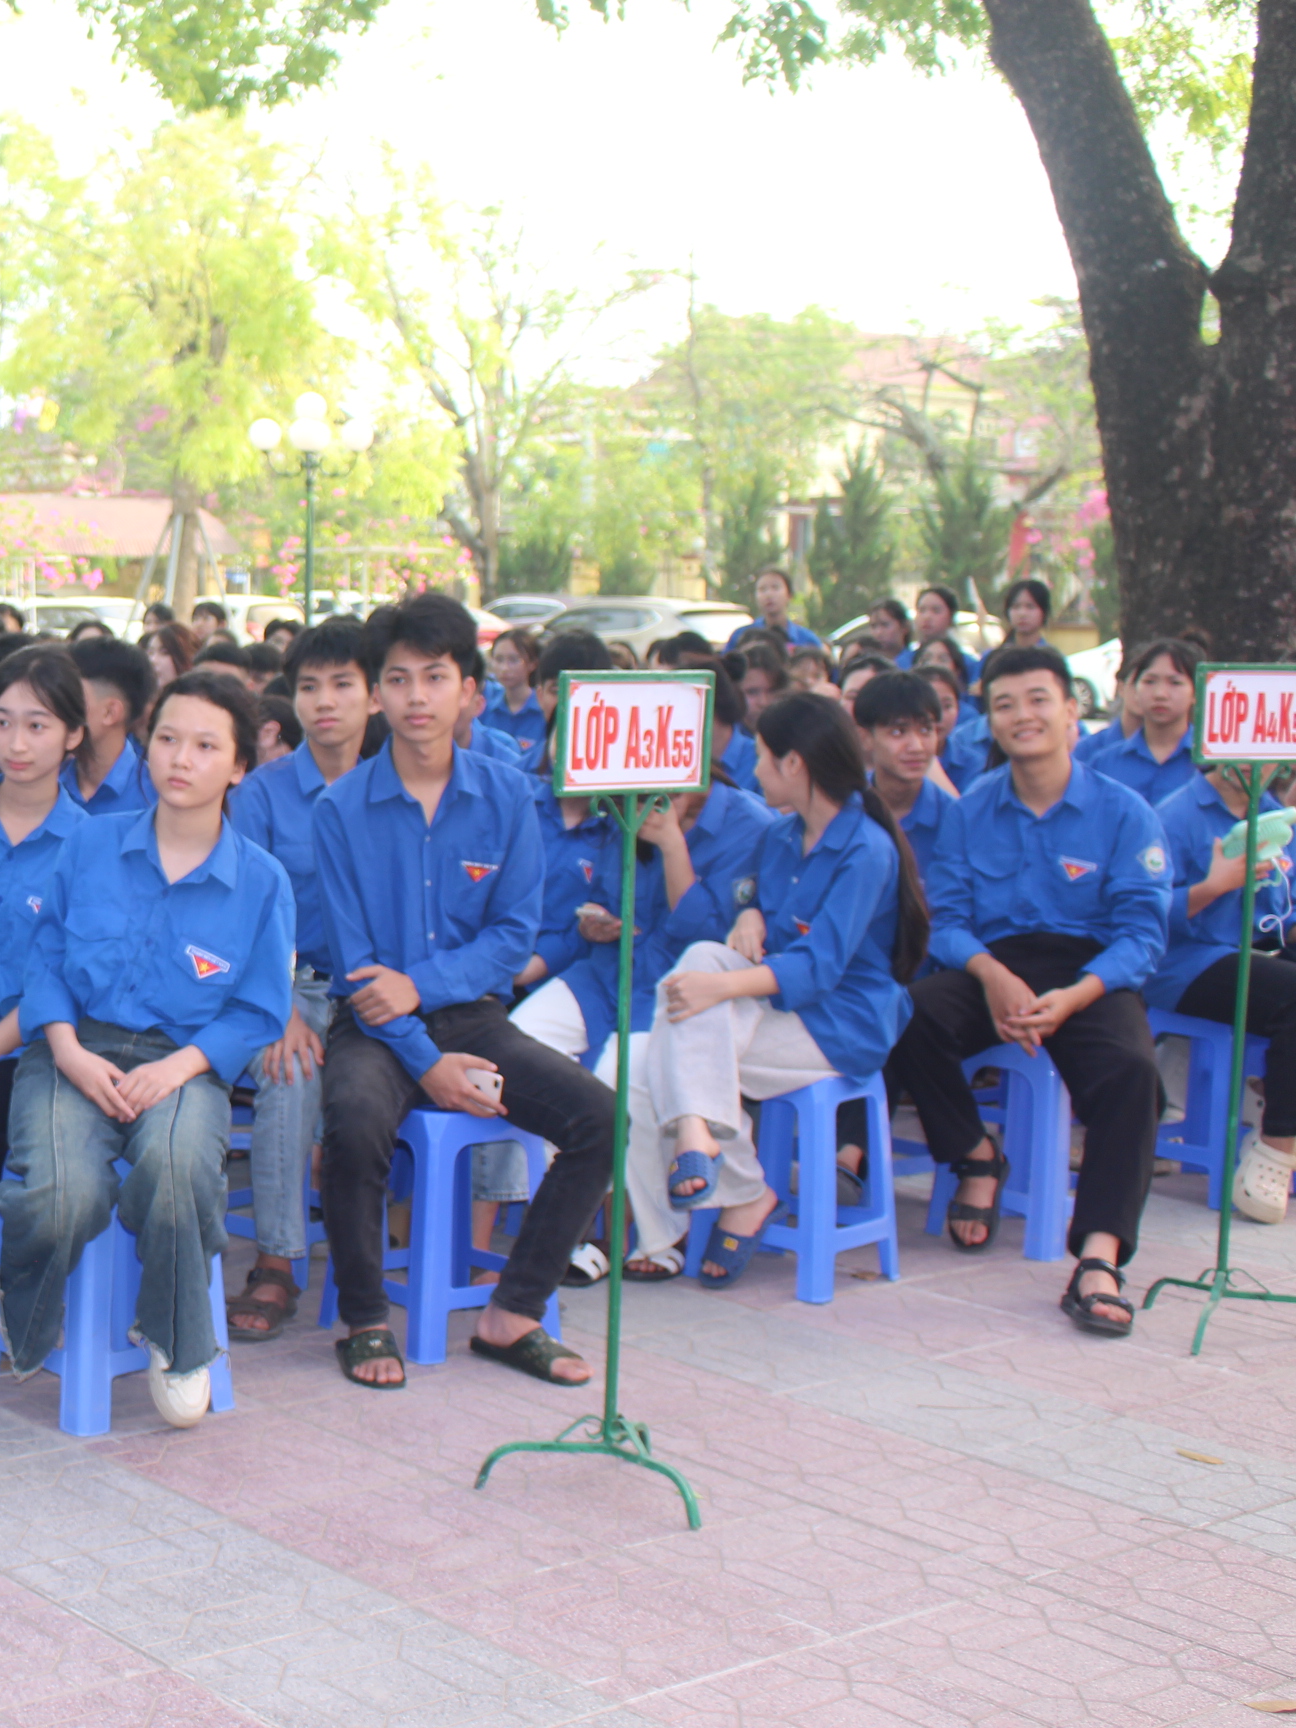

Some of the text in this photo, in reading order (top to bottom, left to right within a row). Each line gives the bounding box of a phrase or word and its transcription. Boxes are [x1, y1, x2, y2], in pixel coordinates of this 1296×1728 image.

[571, 691, 694, 770] LỚP A3K55
[1207, 681, 1249, 743] LỚP
